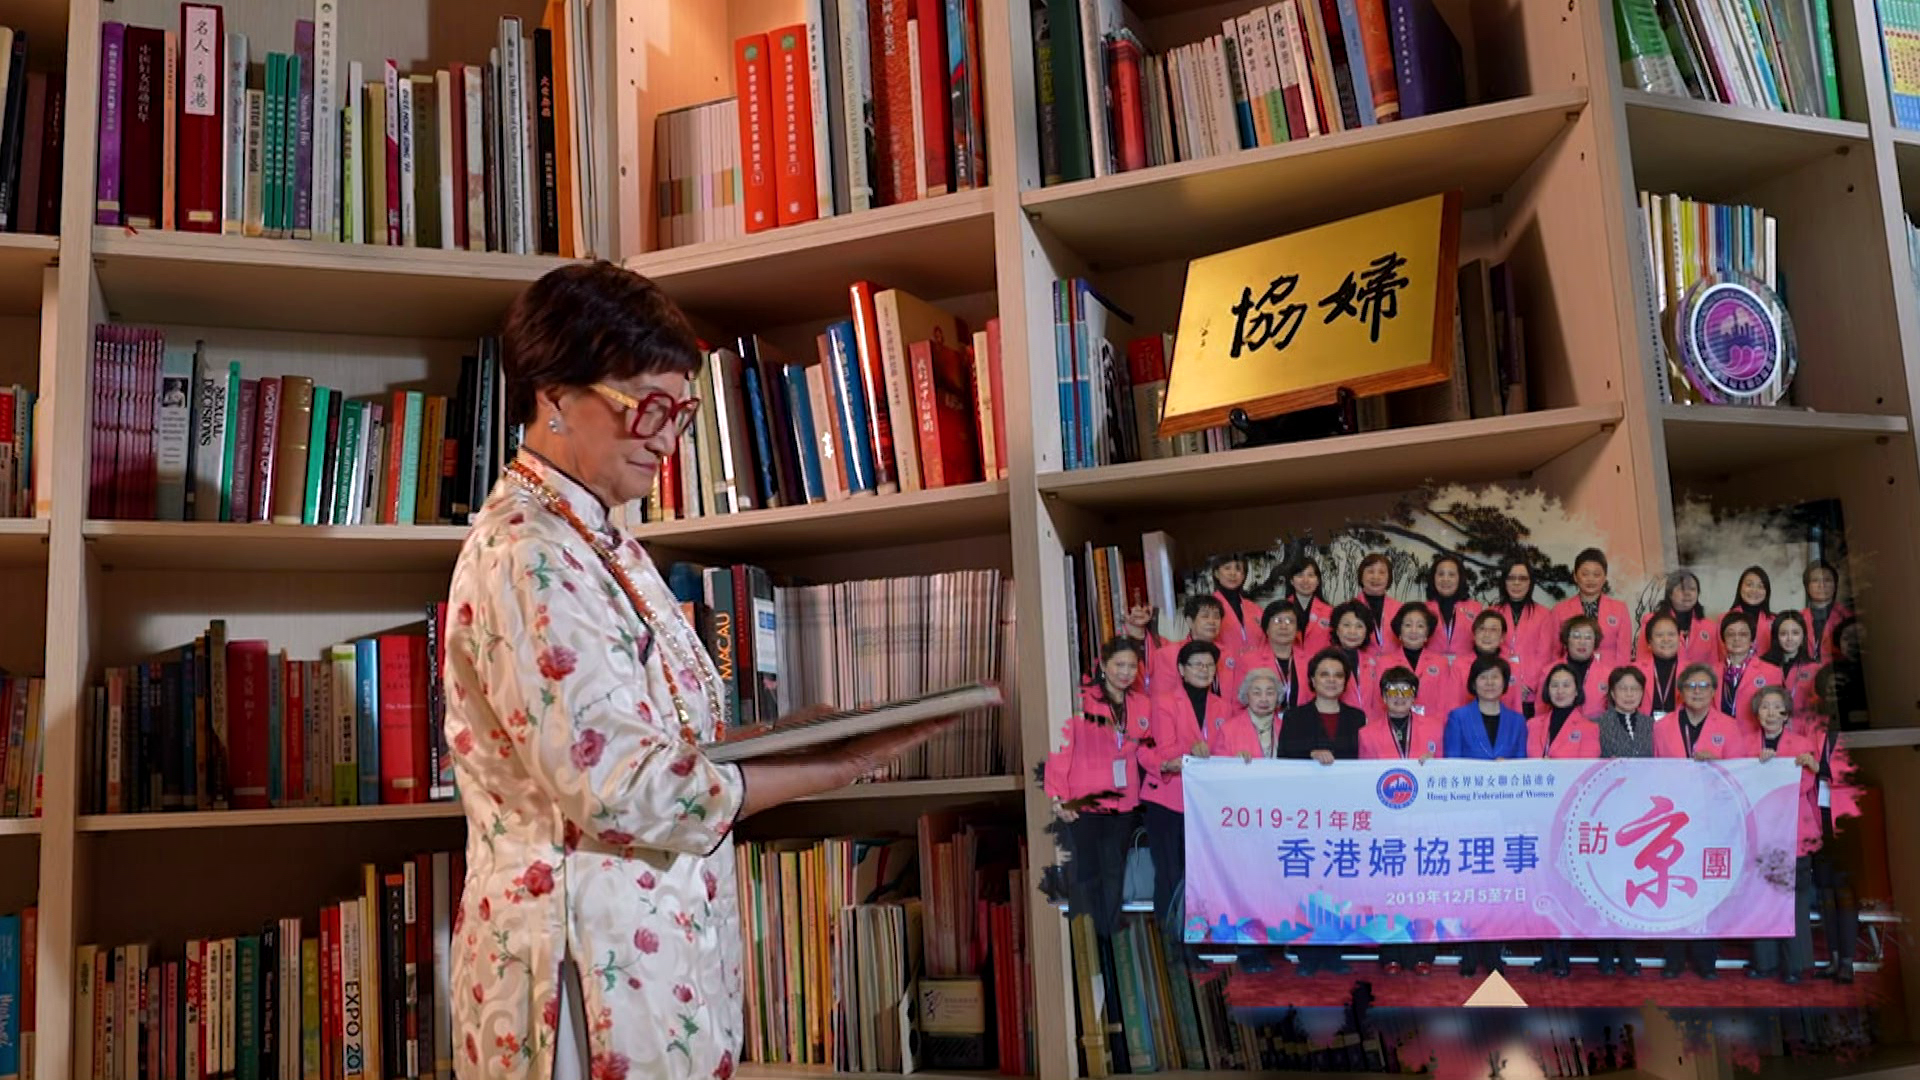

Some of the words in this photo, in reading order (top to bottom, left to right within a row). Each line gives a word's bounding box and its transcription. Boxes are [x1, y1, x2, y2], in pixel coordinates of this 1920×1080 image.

[200, 378, 215, 446] DECISIONS
[213, 386, 225, 438] SEXUAL
[264, 383, 275, 424] WOMEN
[715, 612, 732, 681] MACAU
[1427, 792, 1448, 802] Hong
[1450, 792, 1471, 801] Kong
[1472, 791, 1514, 800] Federation
[1526, 789, 1555, 798] Women
[1221, 806, 1373, 832] 2019-21年度
[1277, 833, 1540, 879] 香港婦協理事
[1385, 886, 1527, 907] 2019年12月5至7日
[345, 981, 360, 1037] EXPO
[346, 1043, 361, 1078] 201
